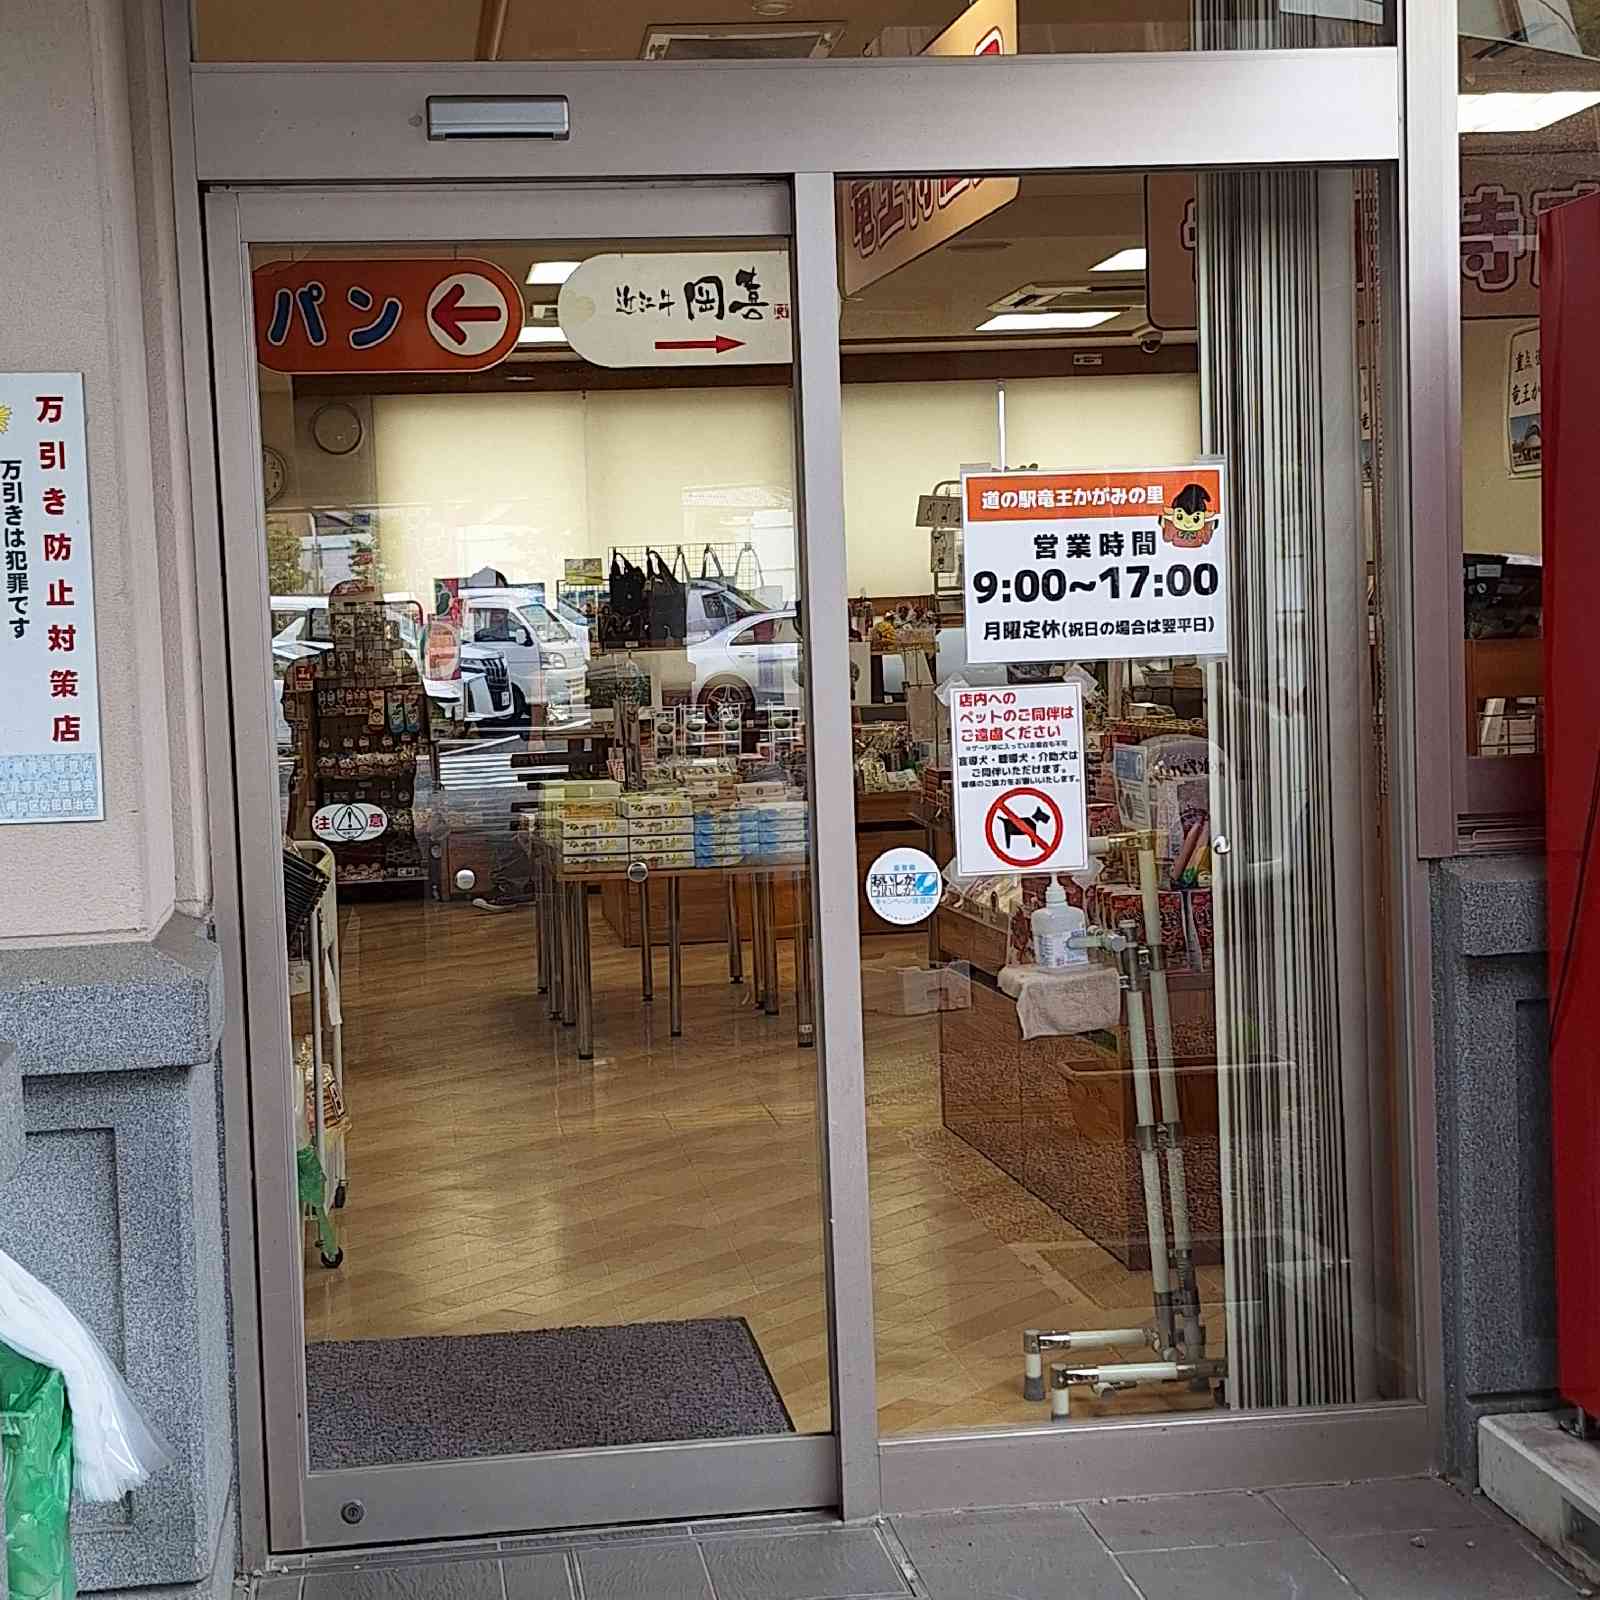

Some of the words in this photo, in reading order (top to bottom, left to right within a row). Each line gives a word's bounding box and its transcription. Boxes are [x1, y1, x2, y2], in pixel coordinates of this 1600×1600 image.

[267, 282, 402, 347] パン
[982, 486, 1164, 509] 道の駅竜王かがみの里
[1, 460, 30, 639] 万引きは犯罪です
[1033, 531, 1156, 559] 営業時間
[36, 396, 81, 743] 万引き防止対策店
[960, 692, 1016, 707] 店内への
[960, 706, 1074, 723] ペットのご同伴は
[961, 725, 1061, 742] ご遠慮ください
